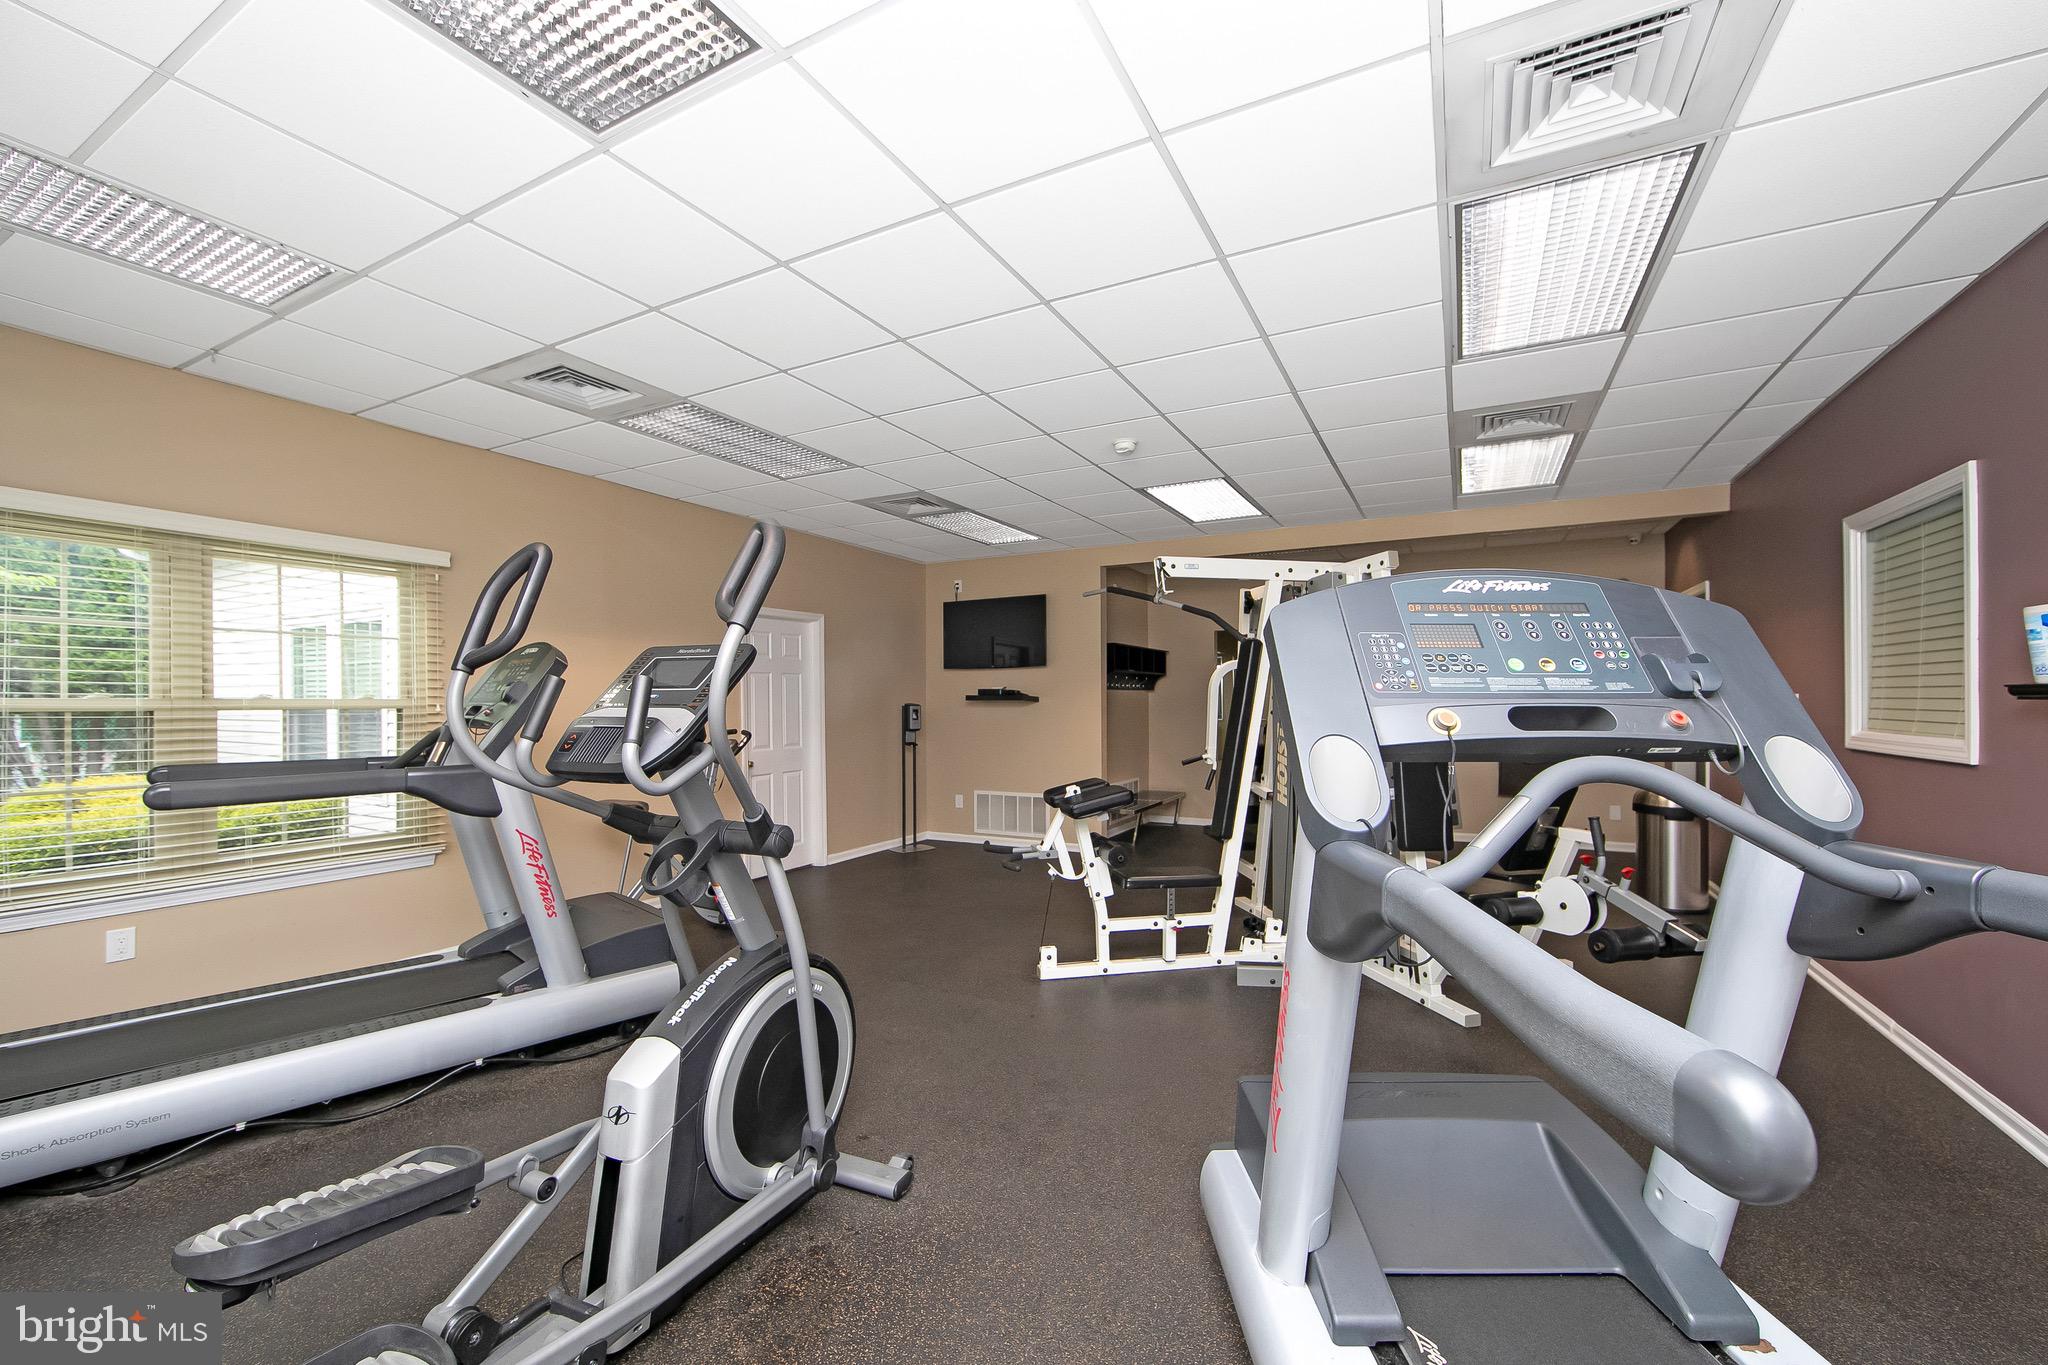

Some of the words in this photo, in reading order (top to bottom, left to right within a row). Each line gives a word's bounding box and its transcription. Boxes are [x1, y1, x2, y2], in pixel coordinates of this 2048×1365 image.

[1442, 579, 1481, 593] Life
[1482, 580, 1551, 594] Fitness
[1408, 604, 1421, 612] OR
[1429, 604, 1463, 612] PRESS
[1470, 604, 1504, 612] QUICK
[1511, 604, 1544, 612] START
[515, 828, 543, 863] Life
[526, 863, 557, 918] Fitness
[667, 956, 738, 1026] NordicTrack
[0, 1143, 46, 1160] Shock
[49, 1123, 122, 1148] Absorption
[125, 1112, 171, 1129] System
